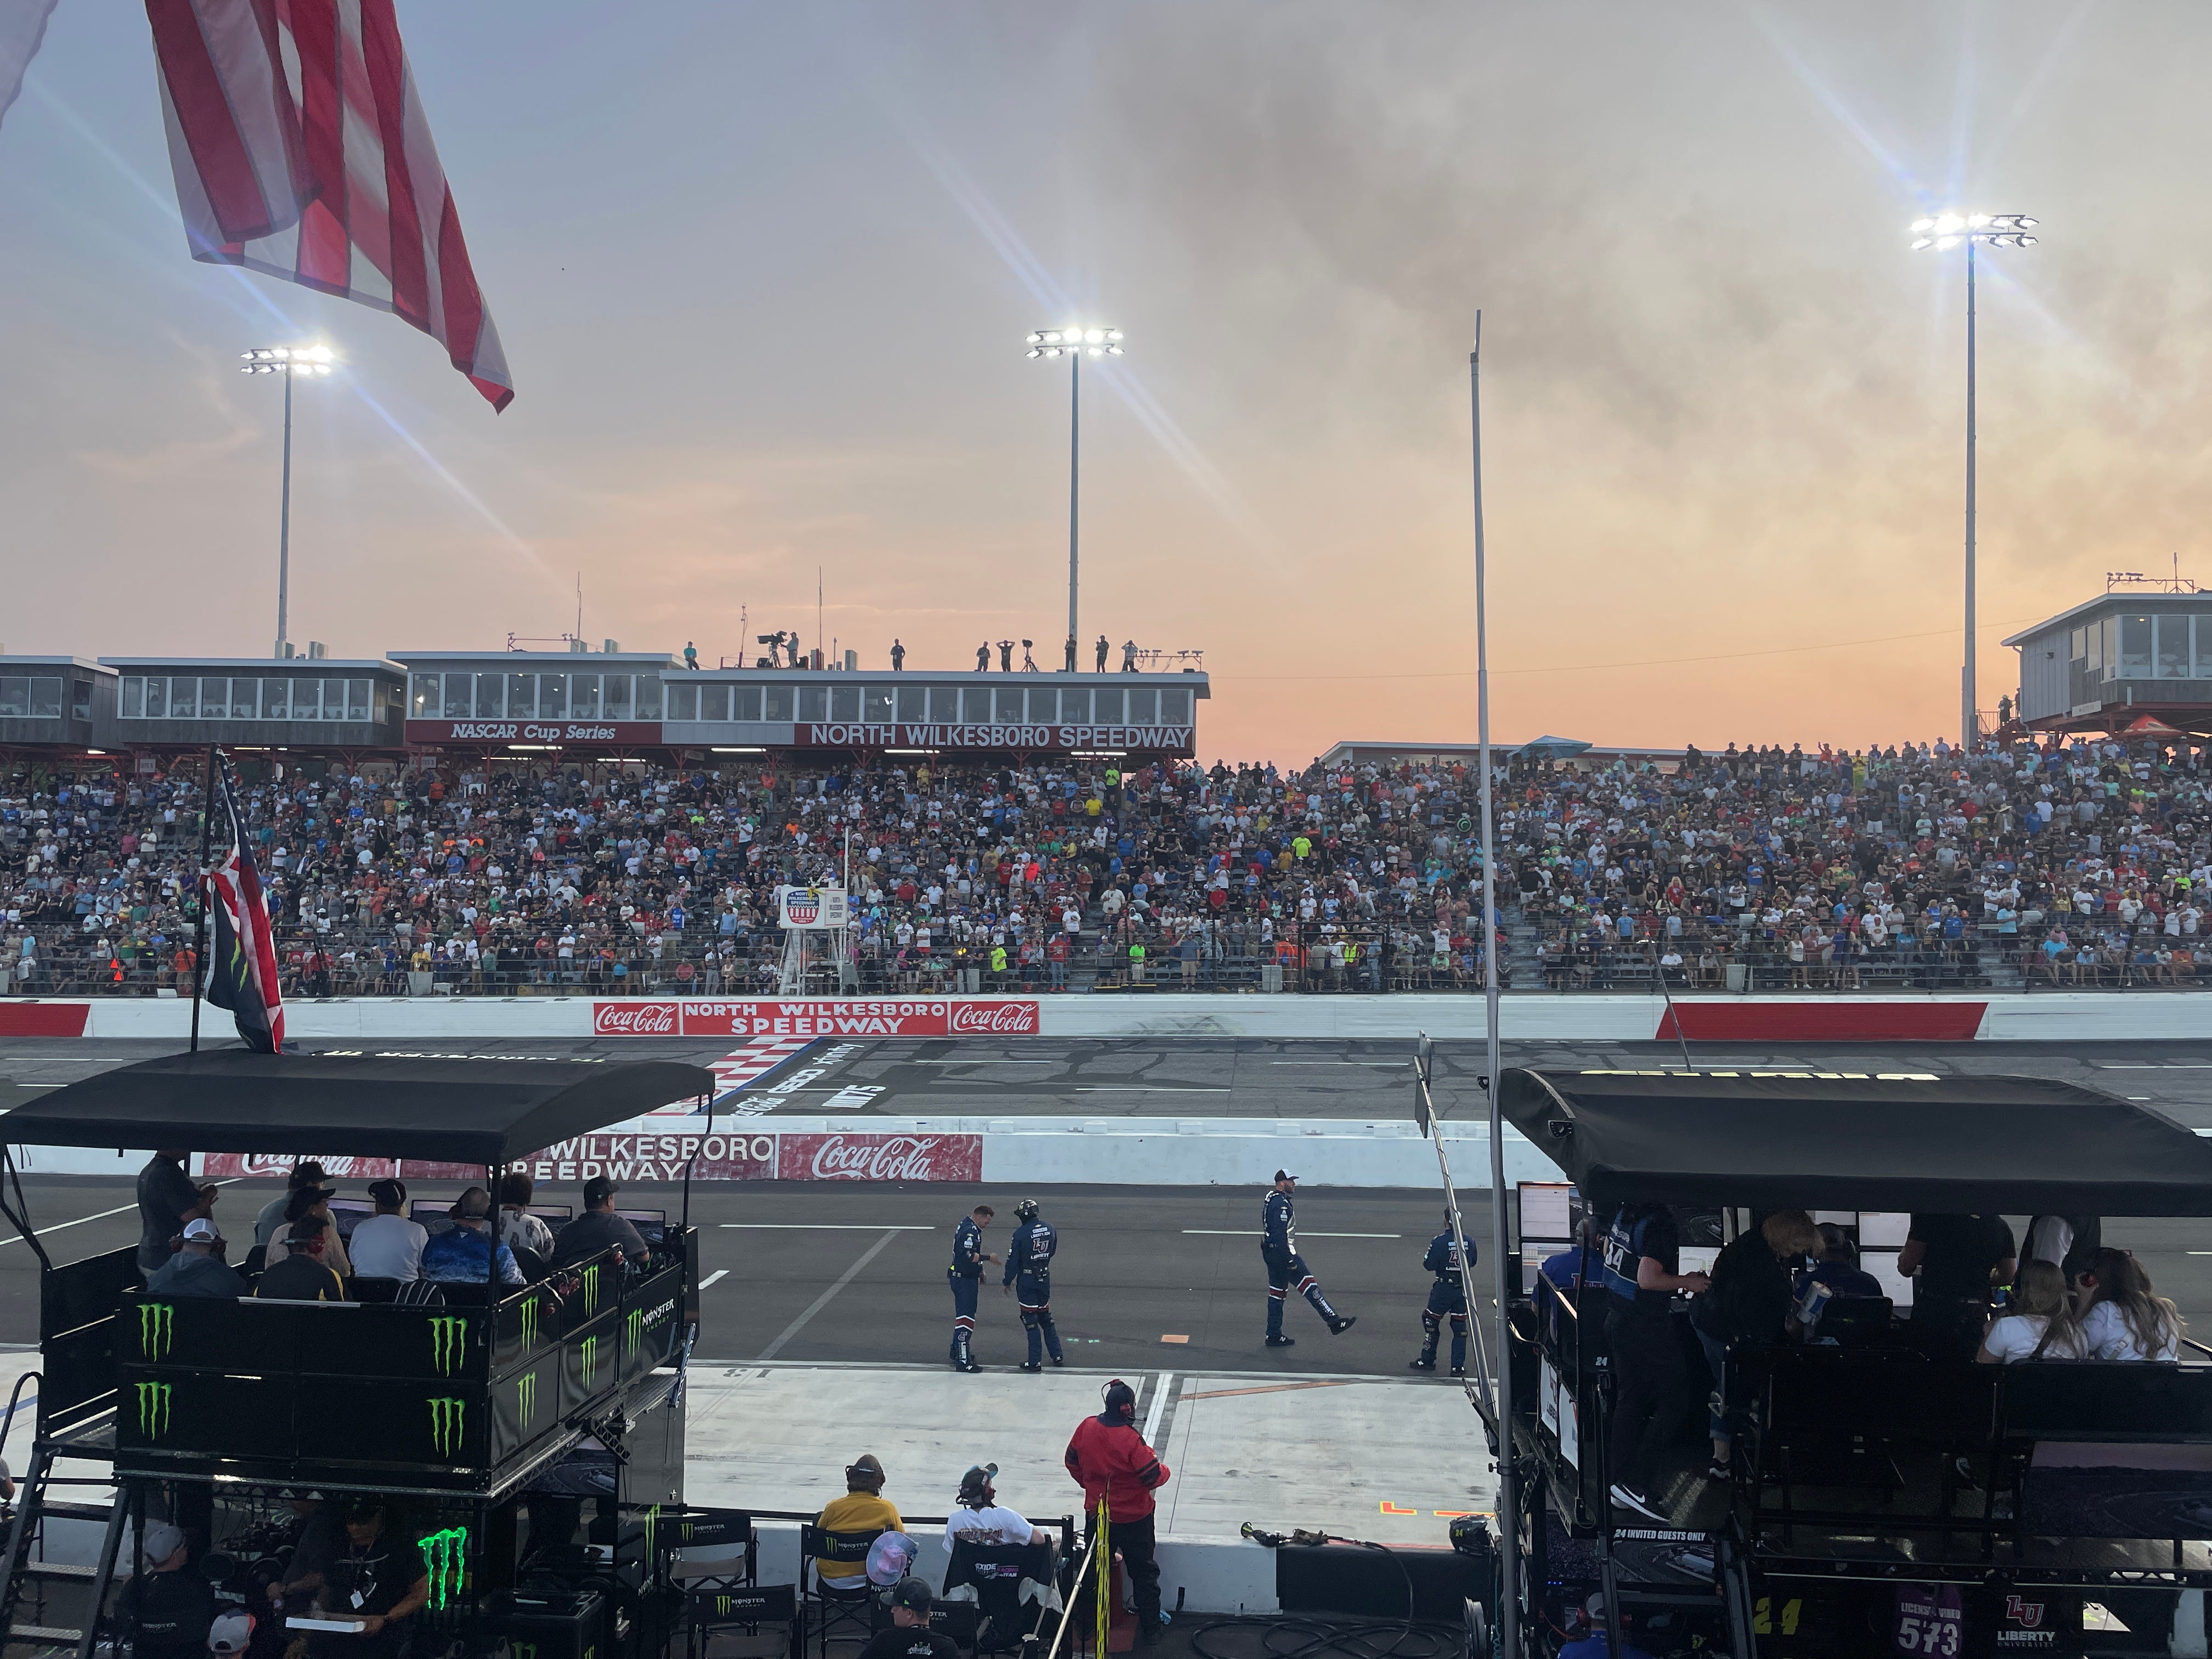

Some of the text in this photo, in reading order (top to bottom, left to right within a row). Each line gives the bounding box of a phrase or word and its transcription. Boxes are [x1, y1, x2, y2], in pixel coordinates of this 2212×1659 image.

[451, 724, 616, 741] NASCAR Cup Series
[811, 724, 1193, 748] NORTH WILKESBORO SPEEDWAY
[596, 1005, 678, 1032] Coca-Cola
[685, 1003, 945, 1017] NORTH WILKESBORO
[952, 1004, 1039, 1031] Coca-Cola
[731, 1018, 905, 1034] SPEEDWAY
[767, 1069, 826, 1093] GEICO
[550, 1137, 774, 1162] WILKESBORO
[812, 1136, 940, 1180] Coca-Cola
[642, 1298, 674, 1327] MONSTER
[1595, 1357, 1608, 1366] 24
[1614, 1529, 1706, 1541] 24 INVITED GUESTS ONLY
[2006, 1595, 2045, 1628] LU
[1997, 1630, 2056, 1641] LIBERTY
